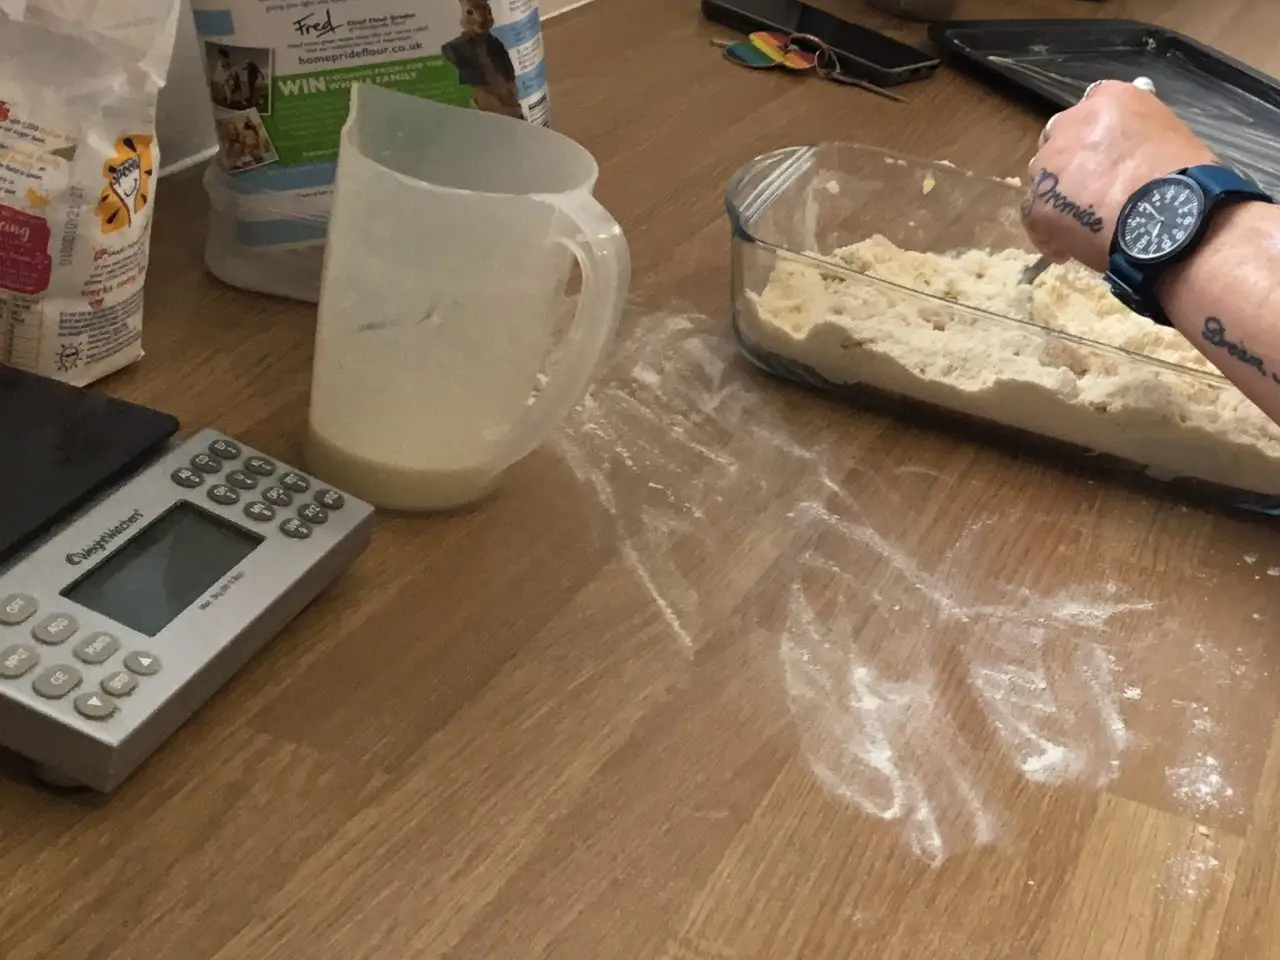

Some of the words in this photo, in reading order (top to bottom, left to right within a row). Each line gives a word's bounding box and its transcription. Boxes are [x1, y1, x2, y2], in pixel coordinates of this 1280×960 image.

[292, 8, 345, 39] Fred
[298, 40, 424, 66] homeprideflour.co.uk
[278, 77, 327, 96] WIN
[1021, 168, 1104, 233] Promise
[80, 508, 144, 559] WeightWatchers
[50, 670, 69, 686] CE
